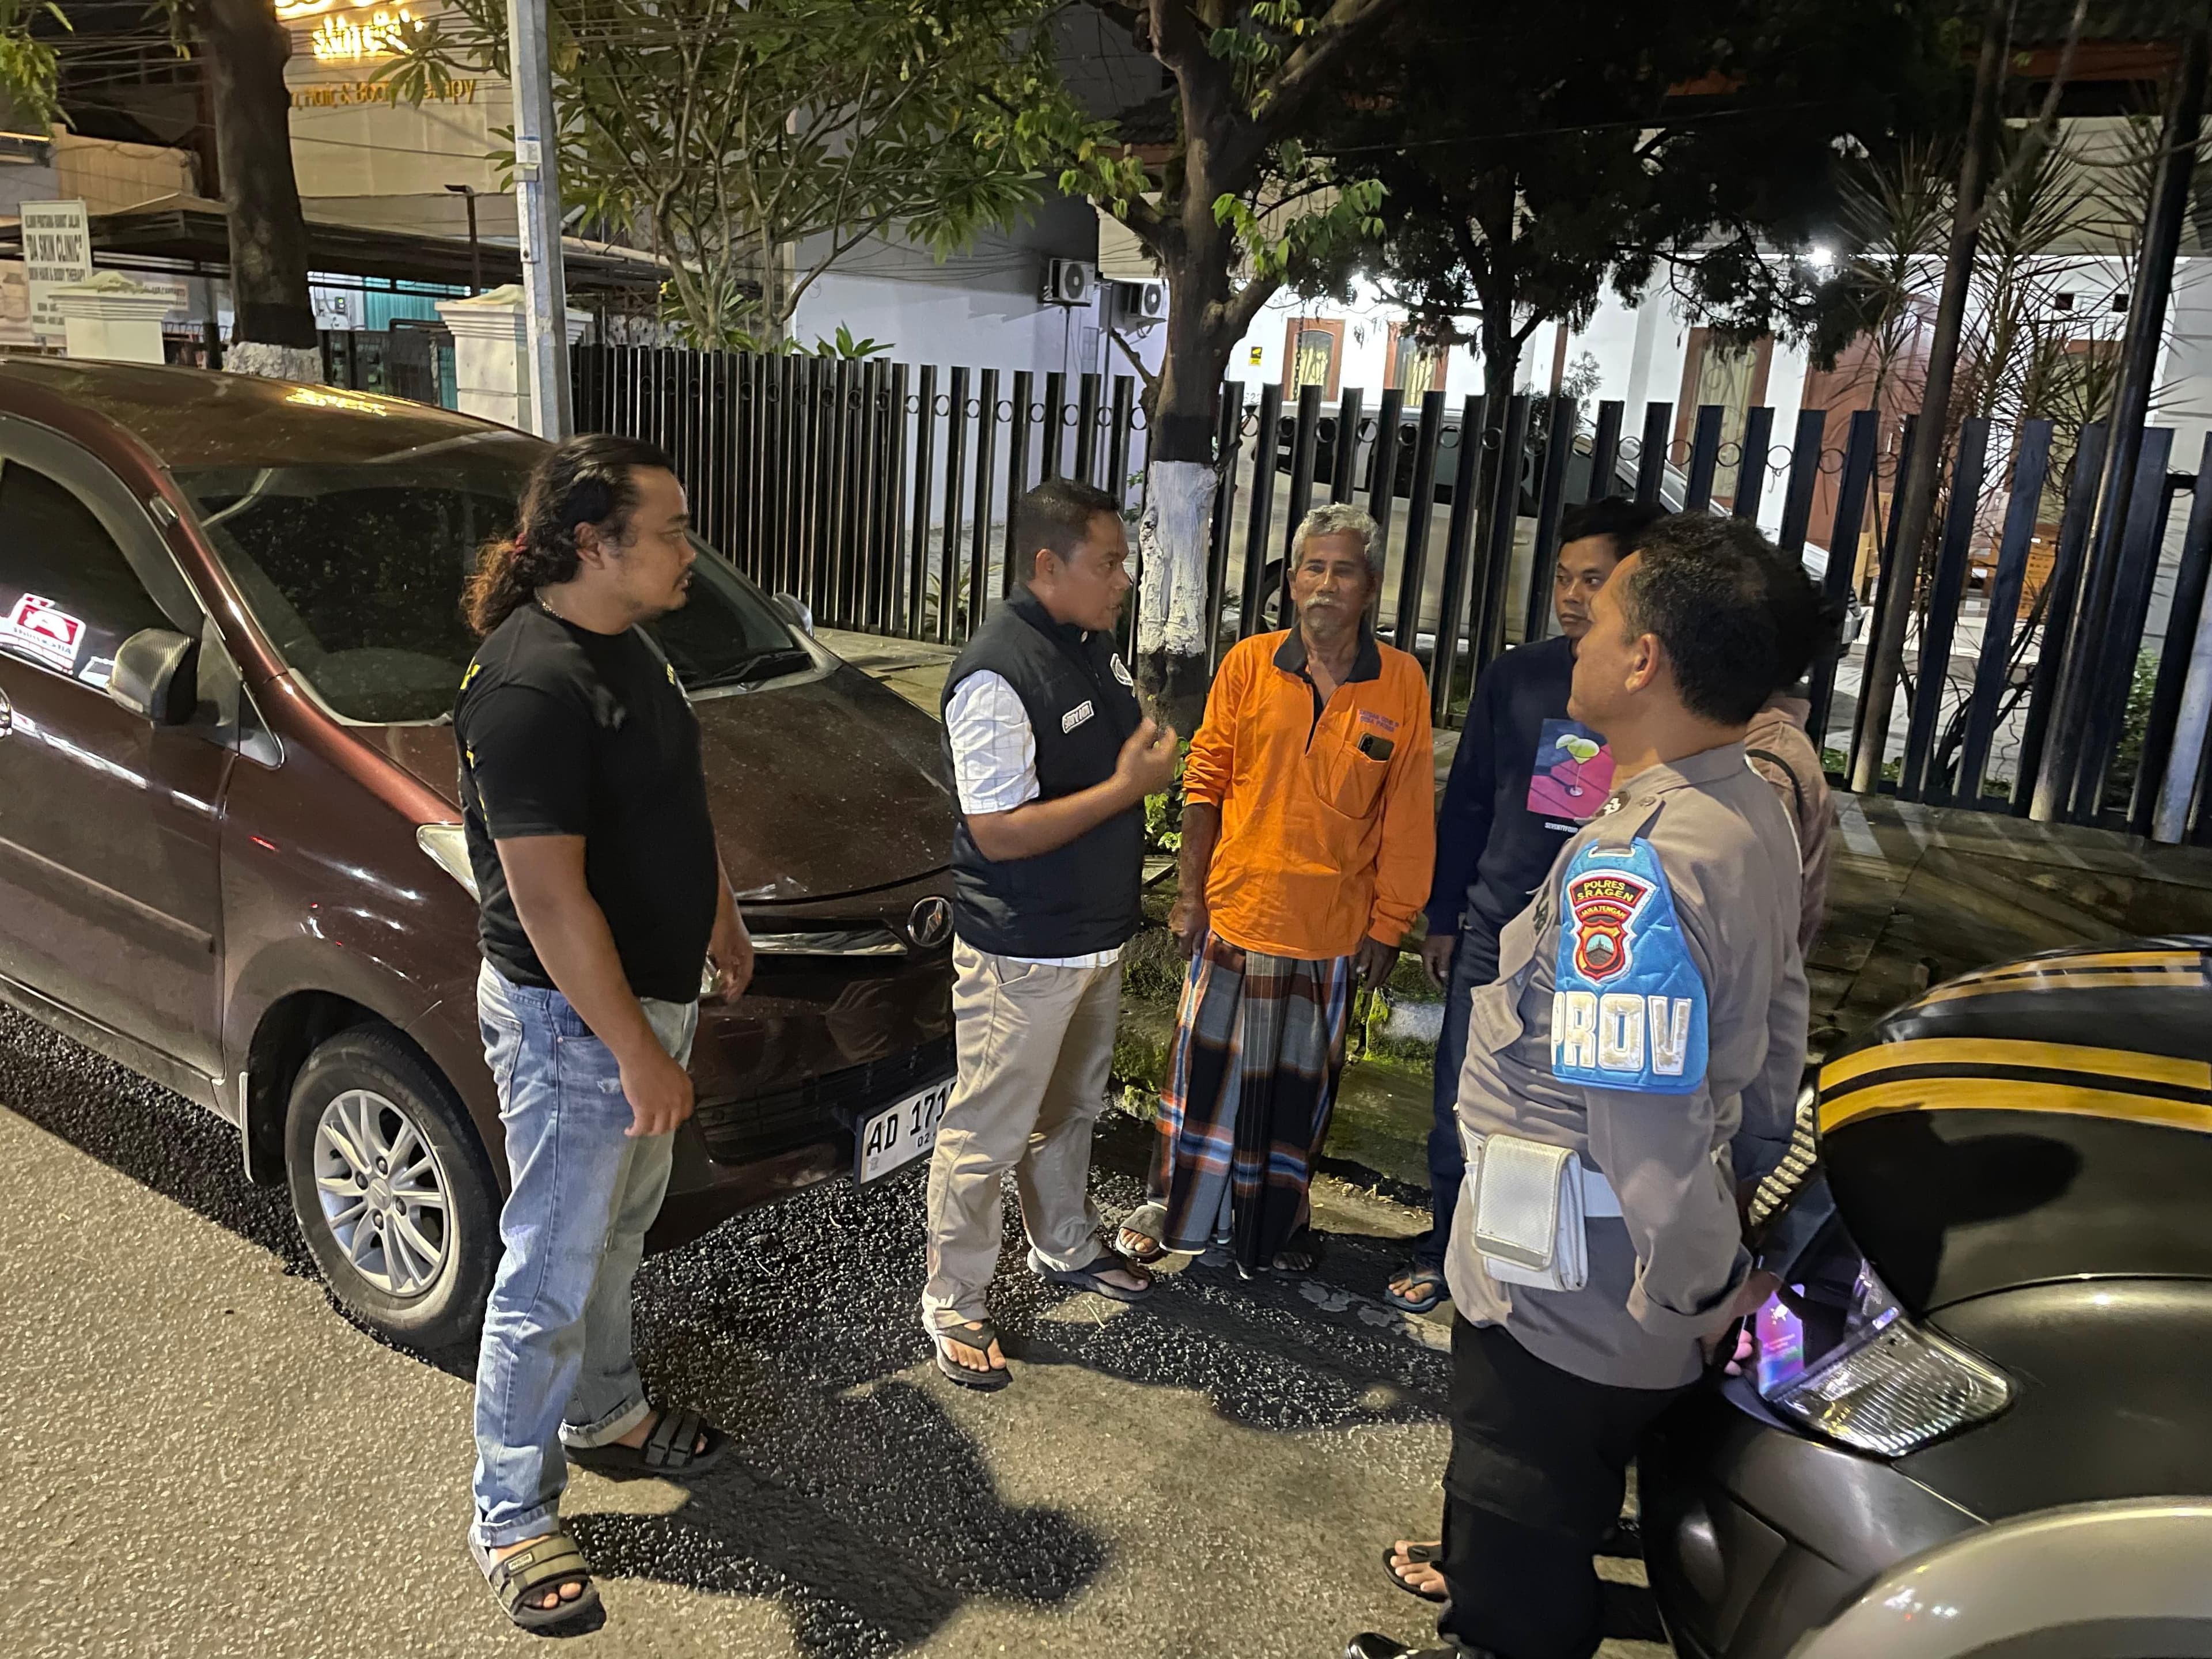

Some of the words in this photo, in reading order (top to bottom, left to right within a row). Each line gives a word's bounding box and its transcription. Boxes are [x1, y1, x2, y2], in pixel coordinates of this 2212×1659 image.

[340, 82, 353, 104] &
[356, 82, 390, 103] Bod
[1584, 880, 1626, 890] POLRES
[1577, 888, 1634, 902] SRAGEN
[866, 1113, 898, 1157] AD
[910, 1081, 957, 1137] 171
